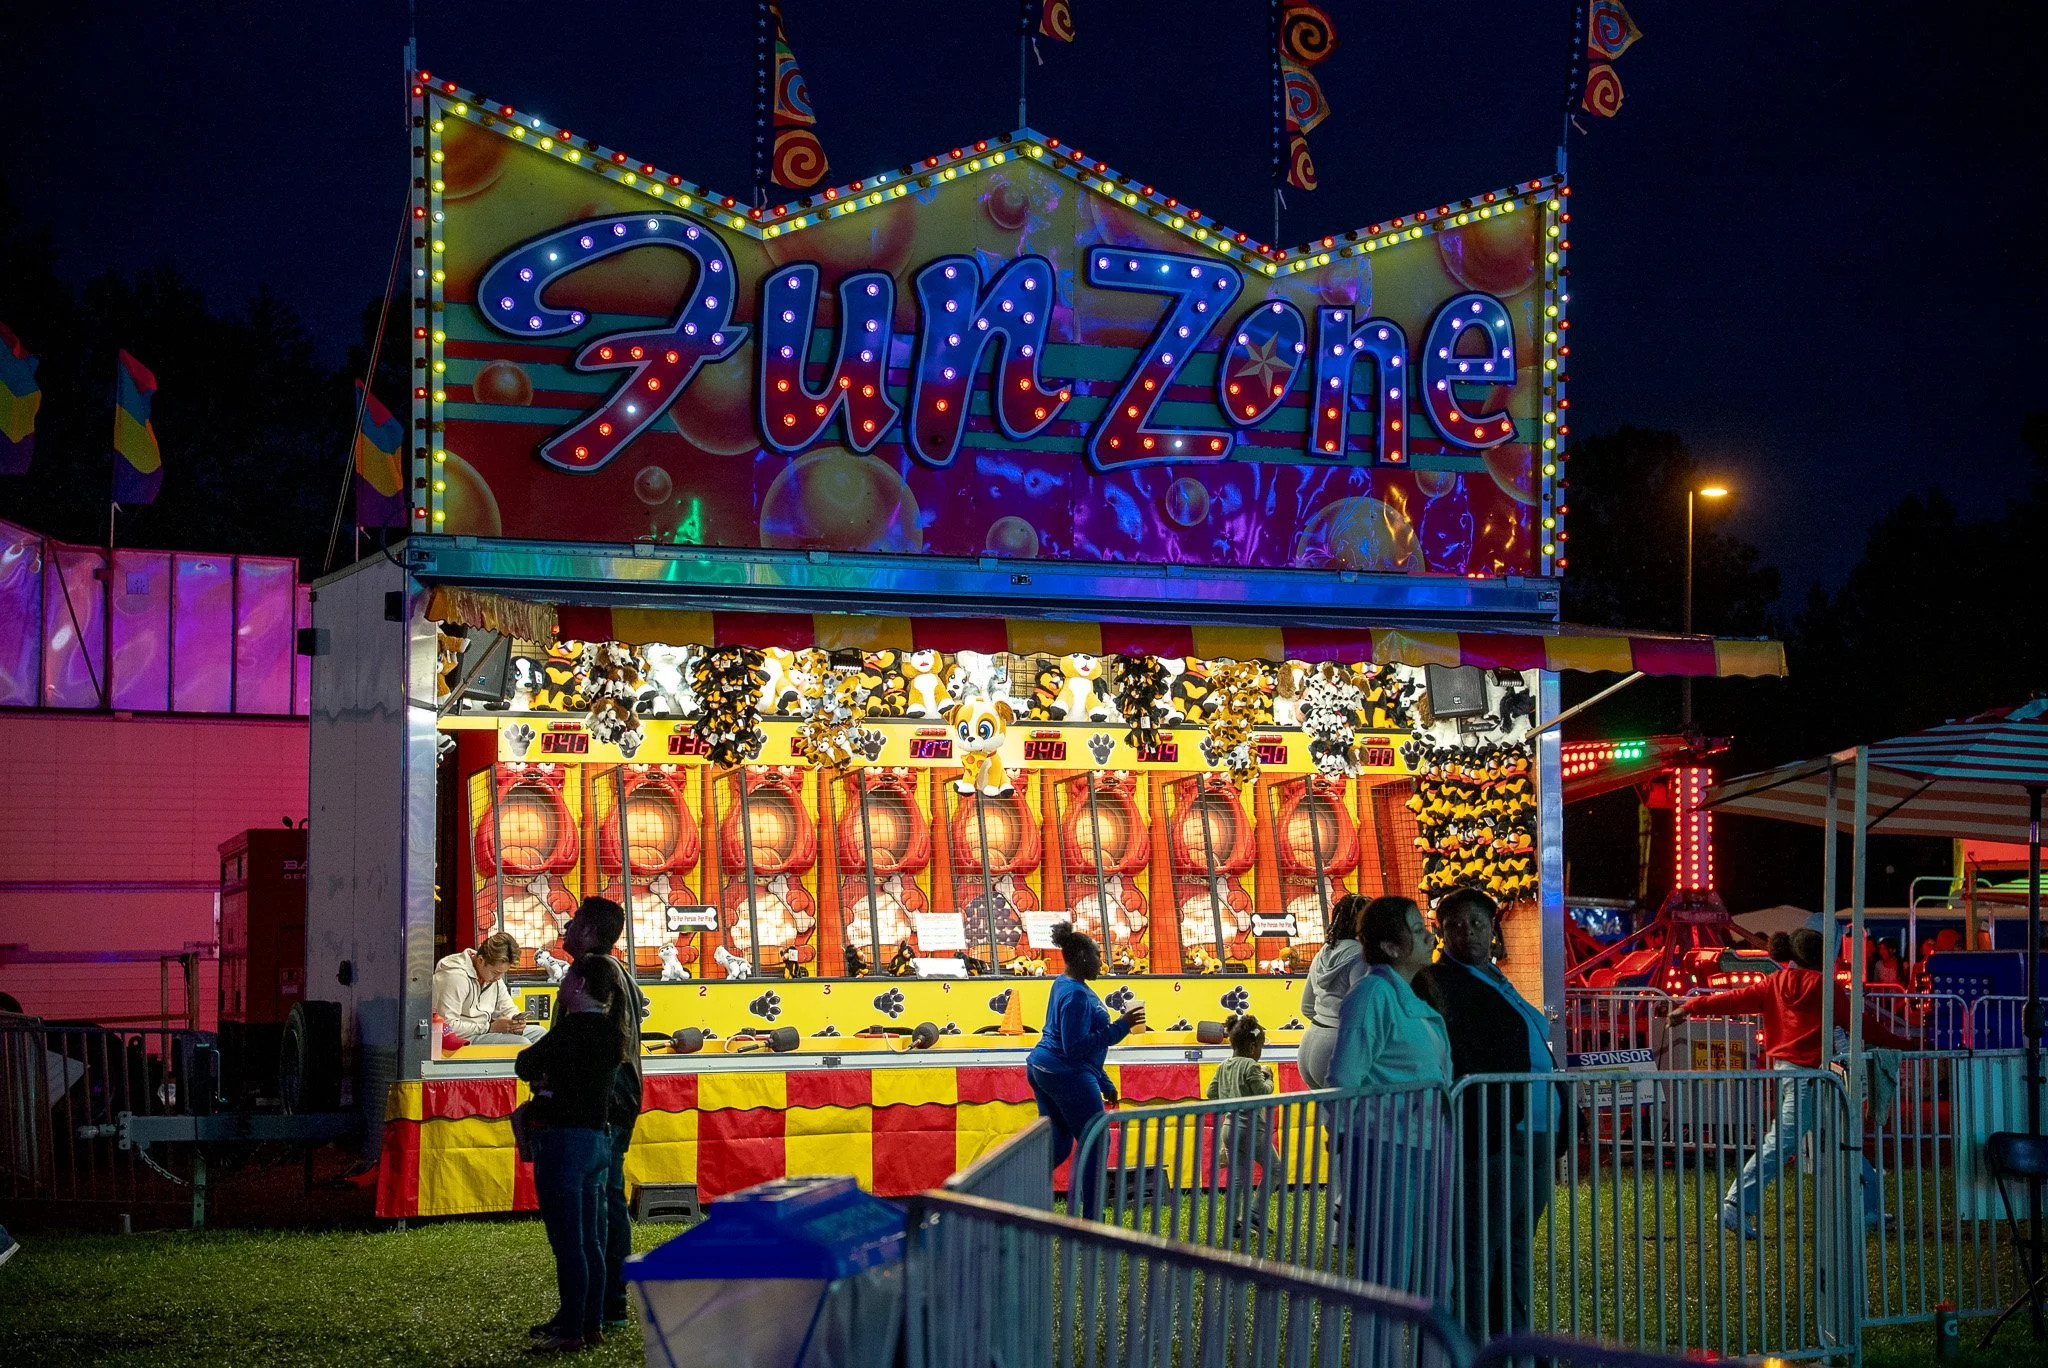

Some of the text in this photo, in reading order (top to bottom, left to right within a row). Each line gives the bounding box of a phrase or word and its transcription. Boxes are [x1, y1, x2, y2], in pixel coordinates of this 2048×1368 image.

[476, 211, 1519, 475] Fun Zone
[541, 733, 588, 753] 040
[699, 985, 707, 996] 2
[823, 984, 831, 995] 3
[1174, 982, 1181, 992] 6
[1285, 980, 1293, 990] 7
[1579, 1050, 1652, 1066] SPONSOR
